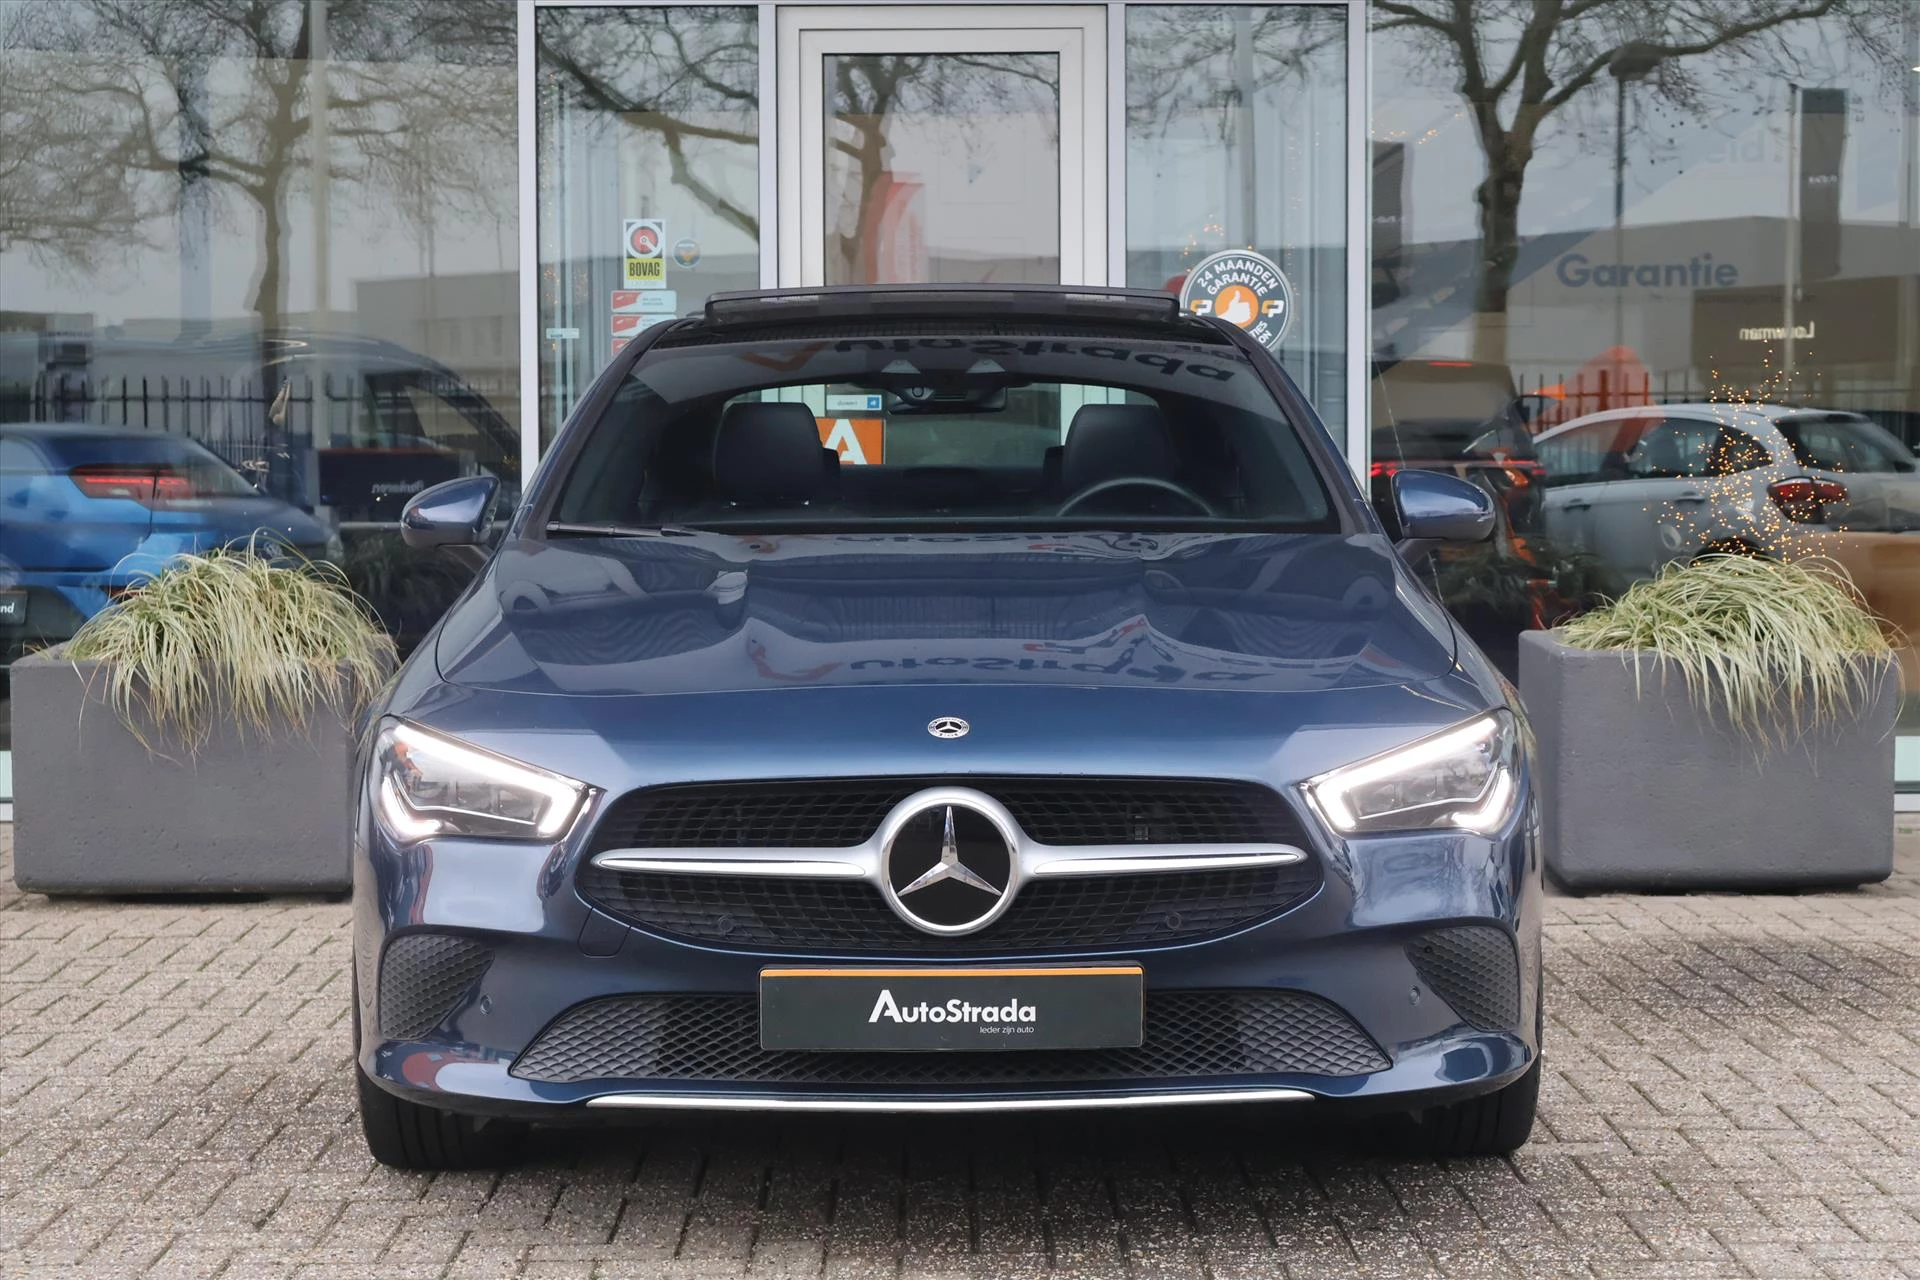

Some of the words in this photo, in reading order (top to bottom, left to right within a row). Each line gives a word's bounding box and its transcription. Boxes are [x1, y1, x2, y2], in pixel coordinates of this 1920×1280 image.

[629, 261, 660, 277] BOVAG
[1197, 271, 1213, 287] 24
[1214, 259, 1278, 289] MAANDEN
[1556, 252, 1739, 288] Garantie
[1207, 272, 1268, 297] GARANTIE
[868, 989, 1036, 1023] AutoStrada
[1002, 1025, 1015, 1035] zijn
[1016, 1025, 1034, 1034] auto
